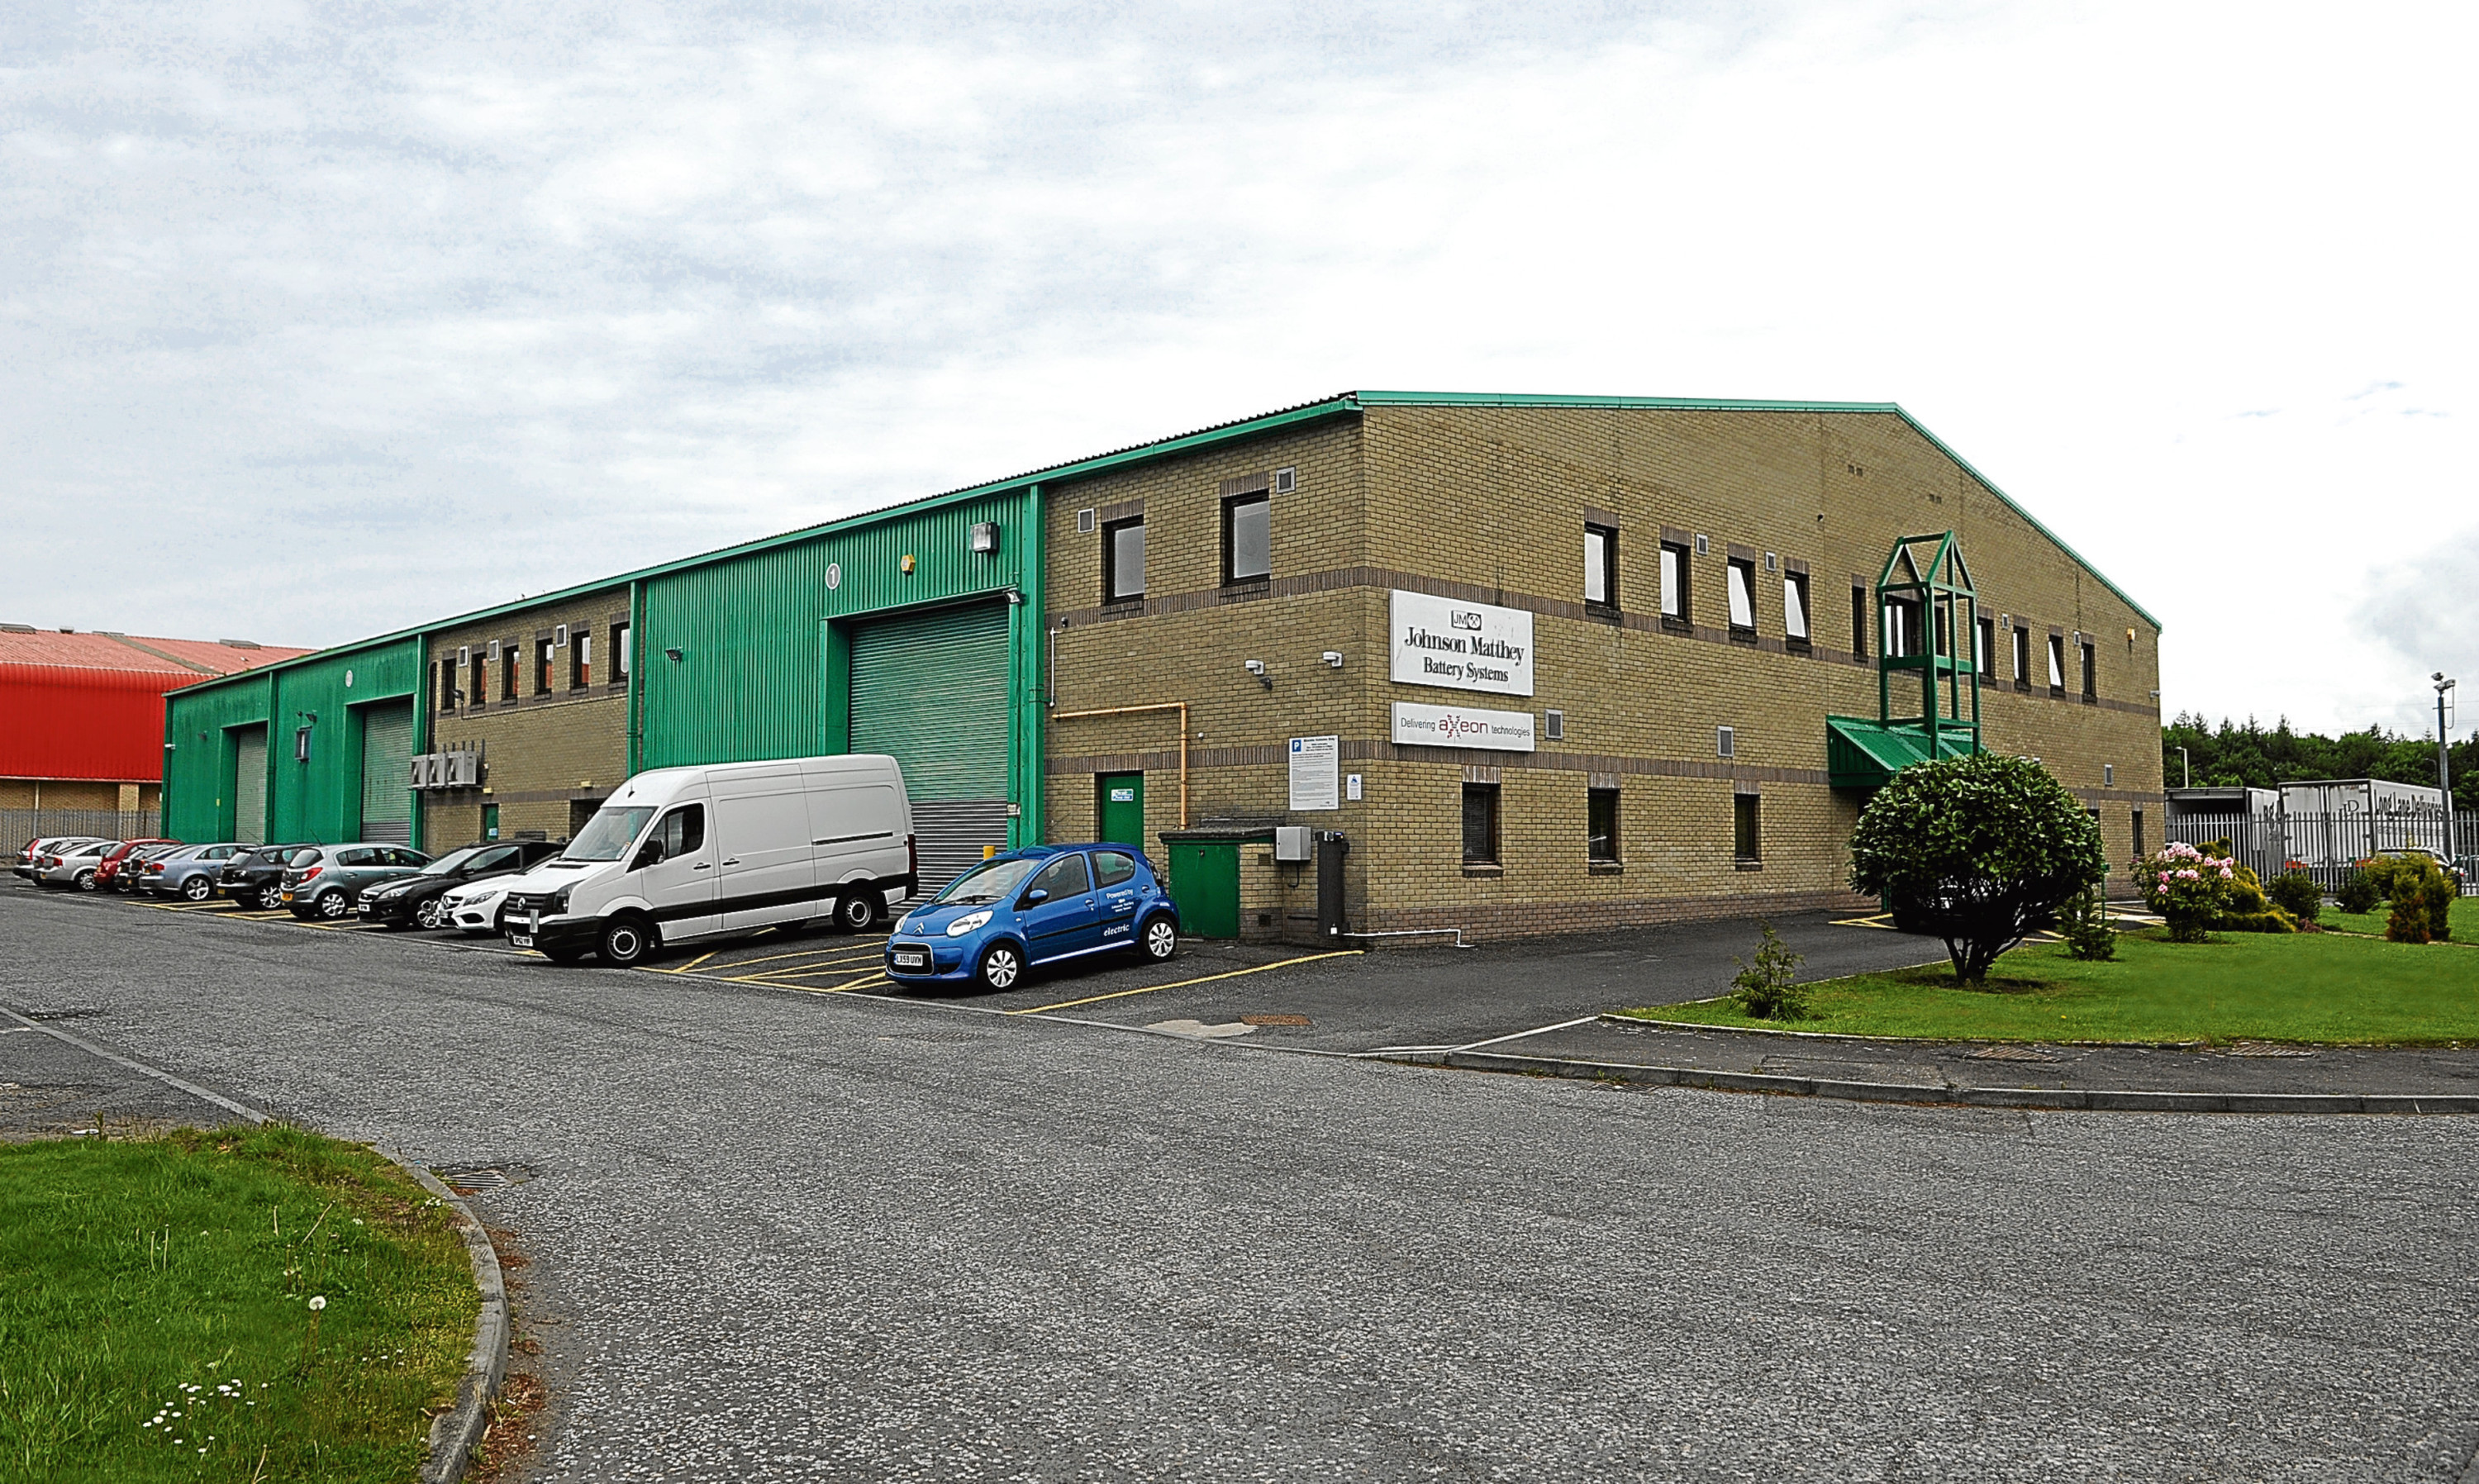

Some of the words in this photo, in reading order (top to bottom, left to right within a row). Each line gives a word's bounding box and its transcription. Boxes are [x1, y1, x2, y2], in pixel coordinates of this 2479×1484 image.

[830, 568, 835, 584] 1
[1454, 613, 1468, 625] JM
[1404, 626, 1467, 653] Johnson
[1470, 635, 1525, 666] Matthey
[1423, 656, 1464, 681] Battery
[1466, 662, 1509, 683] Systems
[1401, 717, 1435, 732] Delivering
[1491, 725, 1530, 739] technologies
[2373, 789, 2392, 820] Long
[2393, 792, 2410, 818] Lane
[2410, 793, 2443, 820] Deliveries
[1106, 889, 1127, 900] Powered
[1103, 924, 1130, 937] electric
